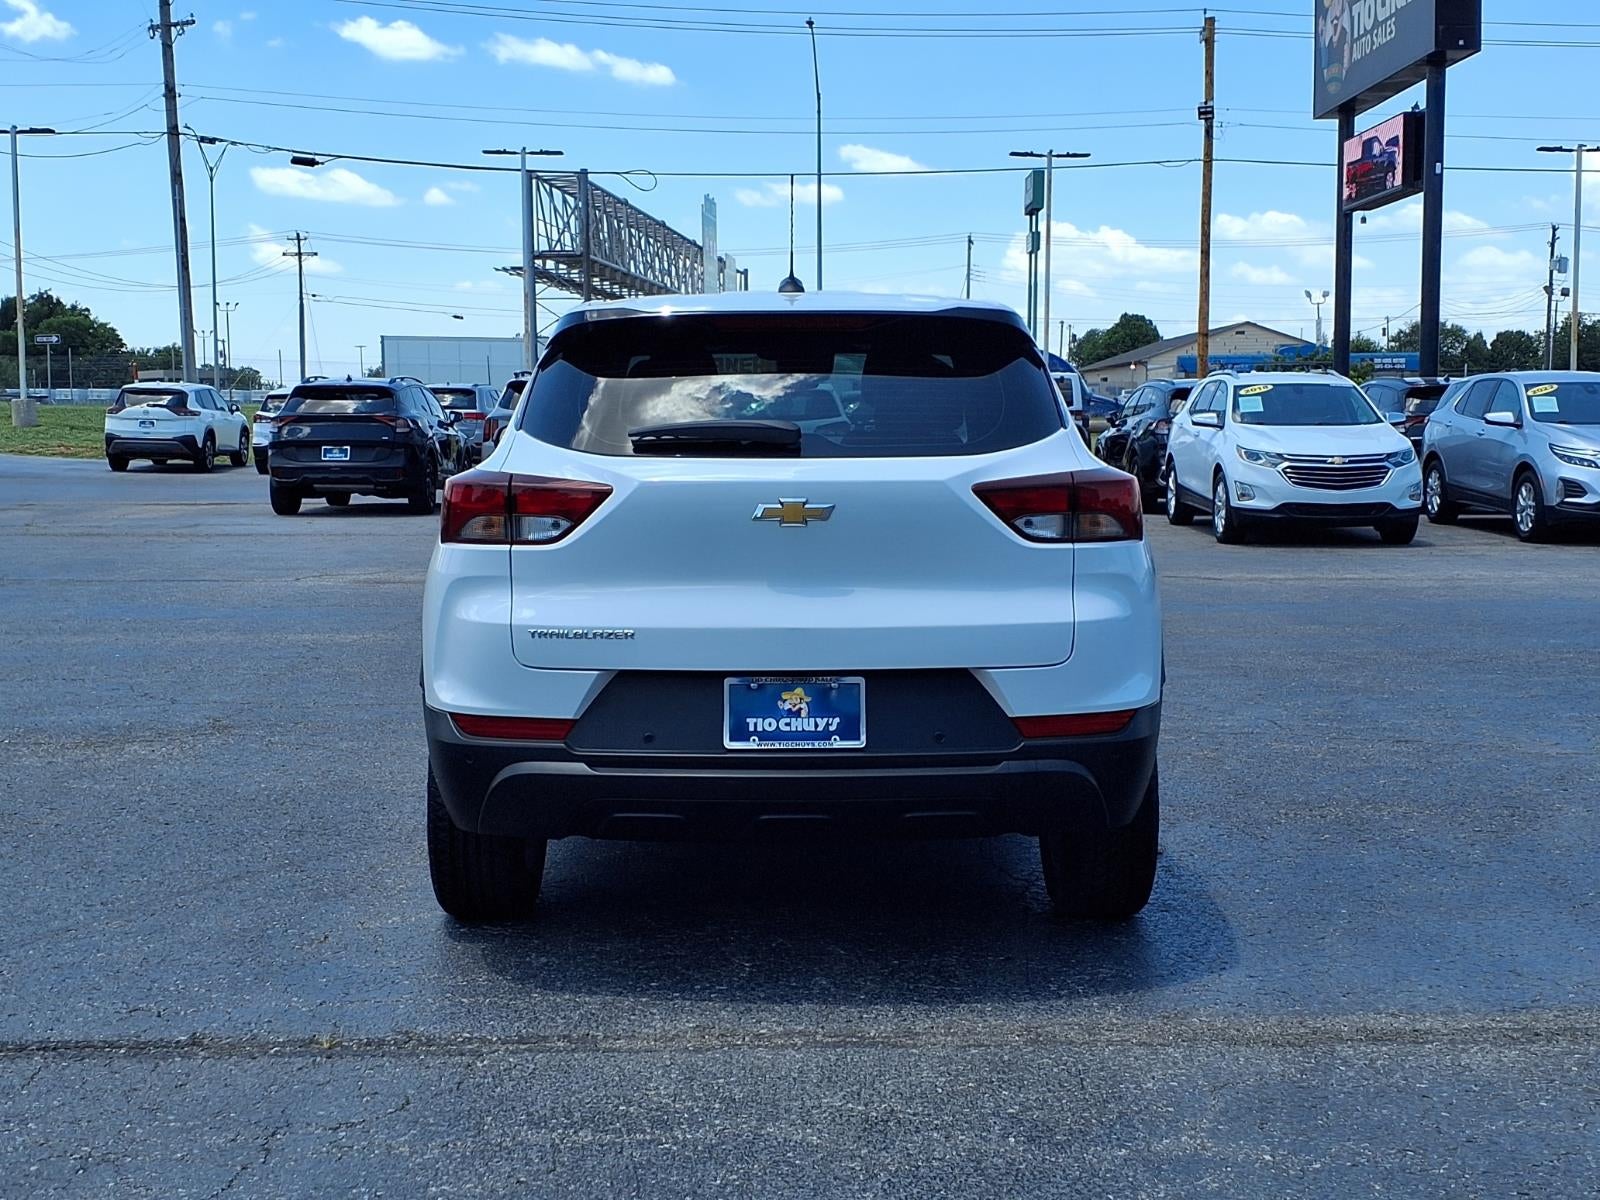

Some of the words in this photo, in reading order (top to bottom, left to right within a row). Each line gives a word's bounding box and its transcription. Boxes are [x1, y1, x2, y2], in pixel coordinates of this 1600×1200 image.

[1352, 33, 1372, 62] AUTO
[1372, 17, 1396, 50] SALES
[528, 629, 635, 640] TRAILBLAZER
